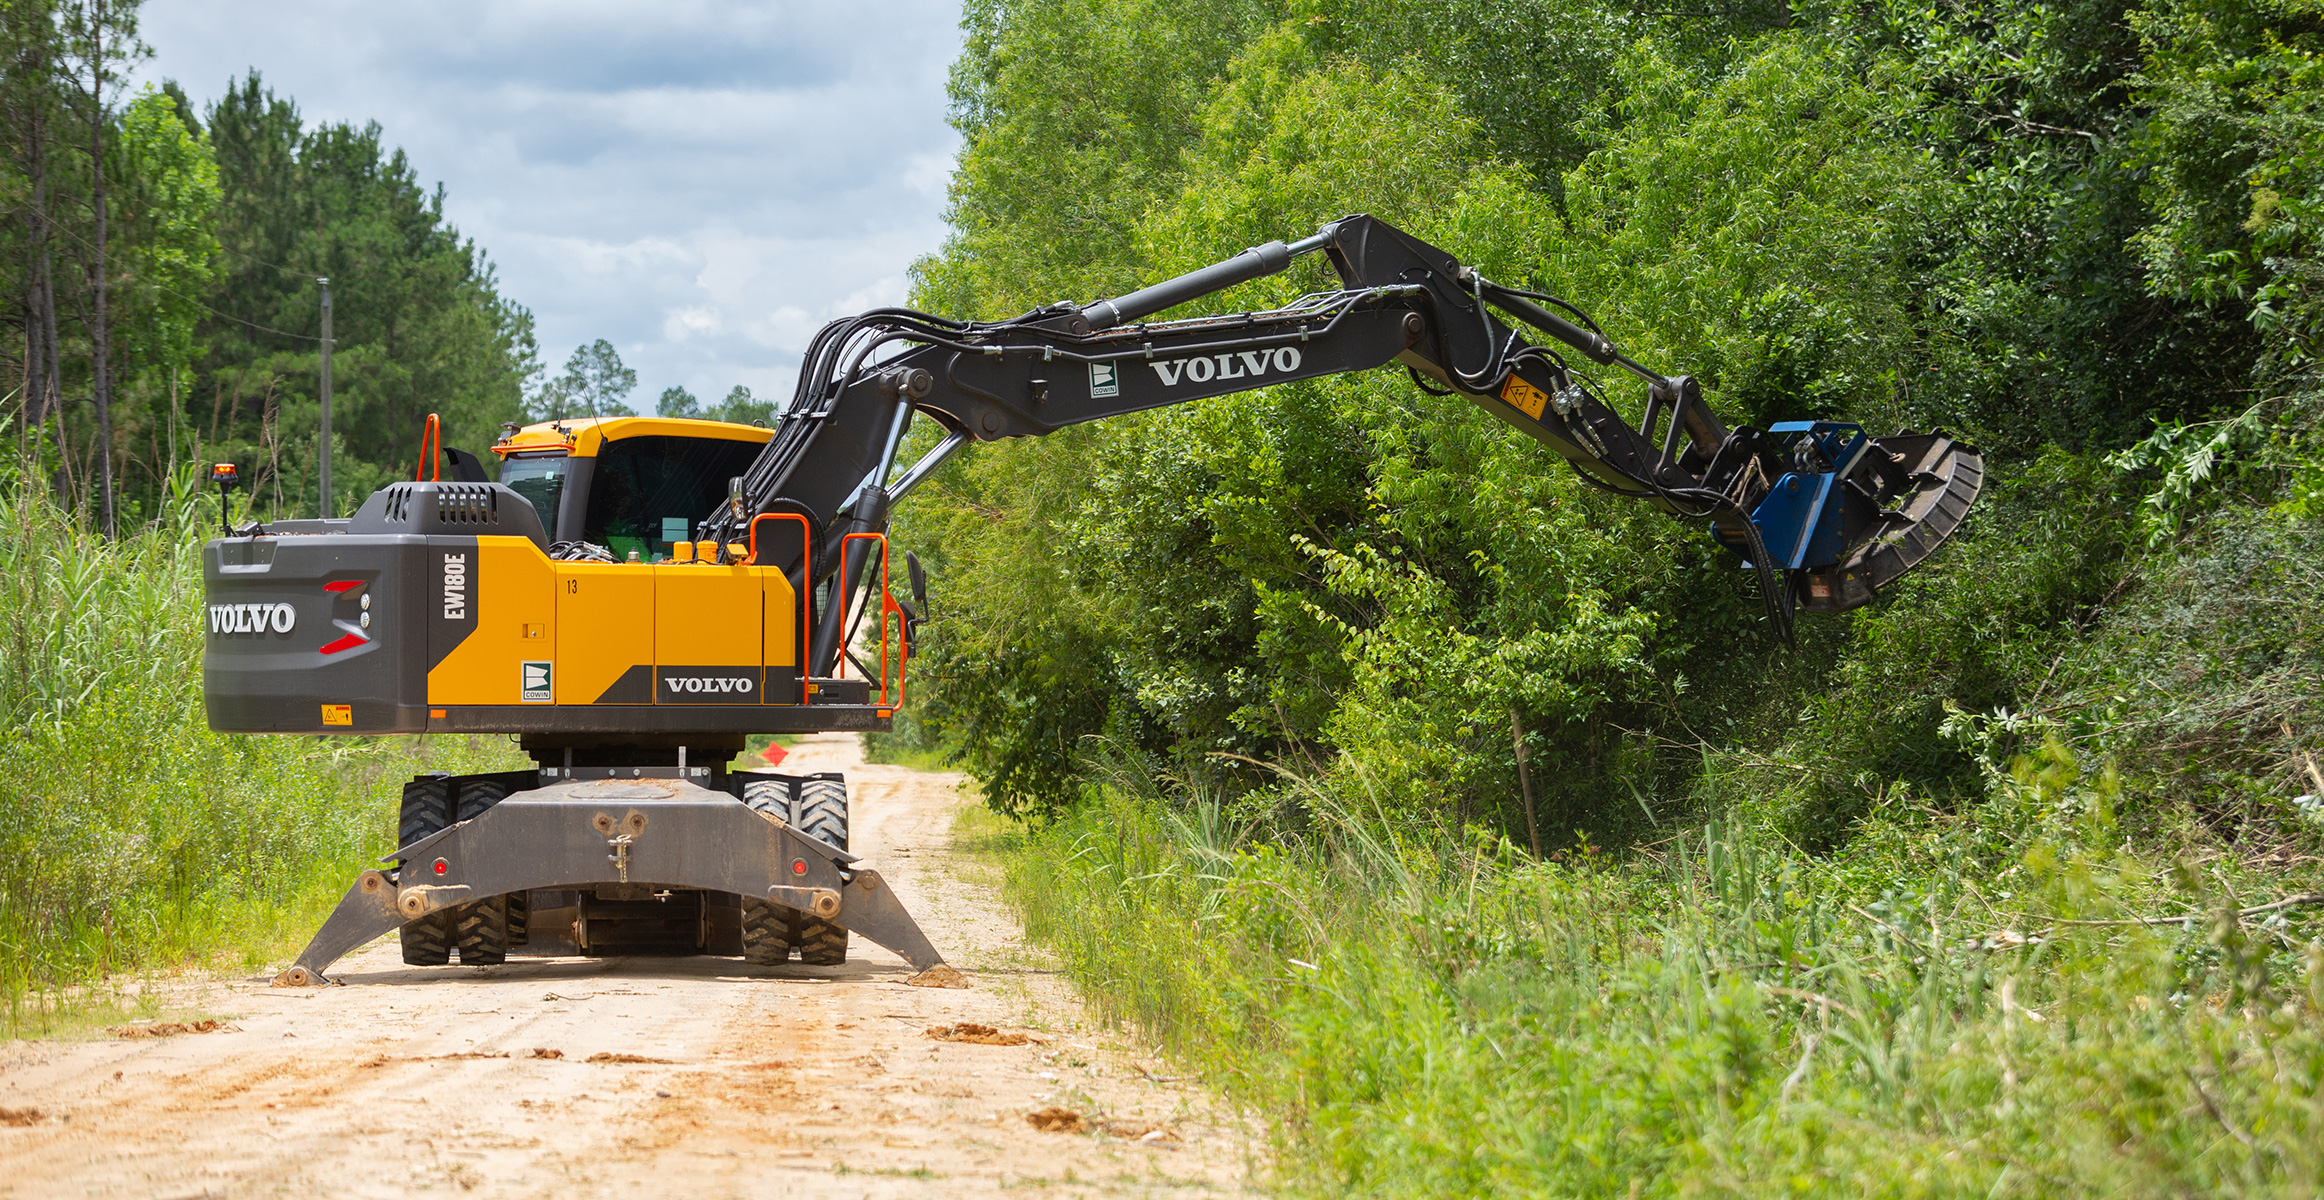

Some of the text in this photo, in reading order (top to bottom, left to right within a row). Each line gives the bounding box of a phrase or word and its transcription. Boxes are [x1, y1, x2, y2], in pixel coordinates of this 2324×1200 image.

[1149, 346, 1301, 386] VOLVO
[444, 553, 465, 619] EW180E
[567, 579, 578, 594] 13
[210, 603, 297, 634] VOLVO
[665, 677, 753, 693] VOLVO
